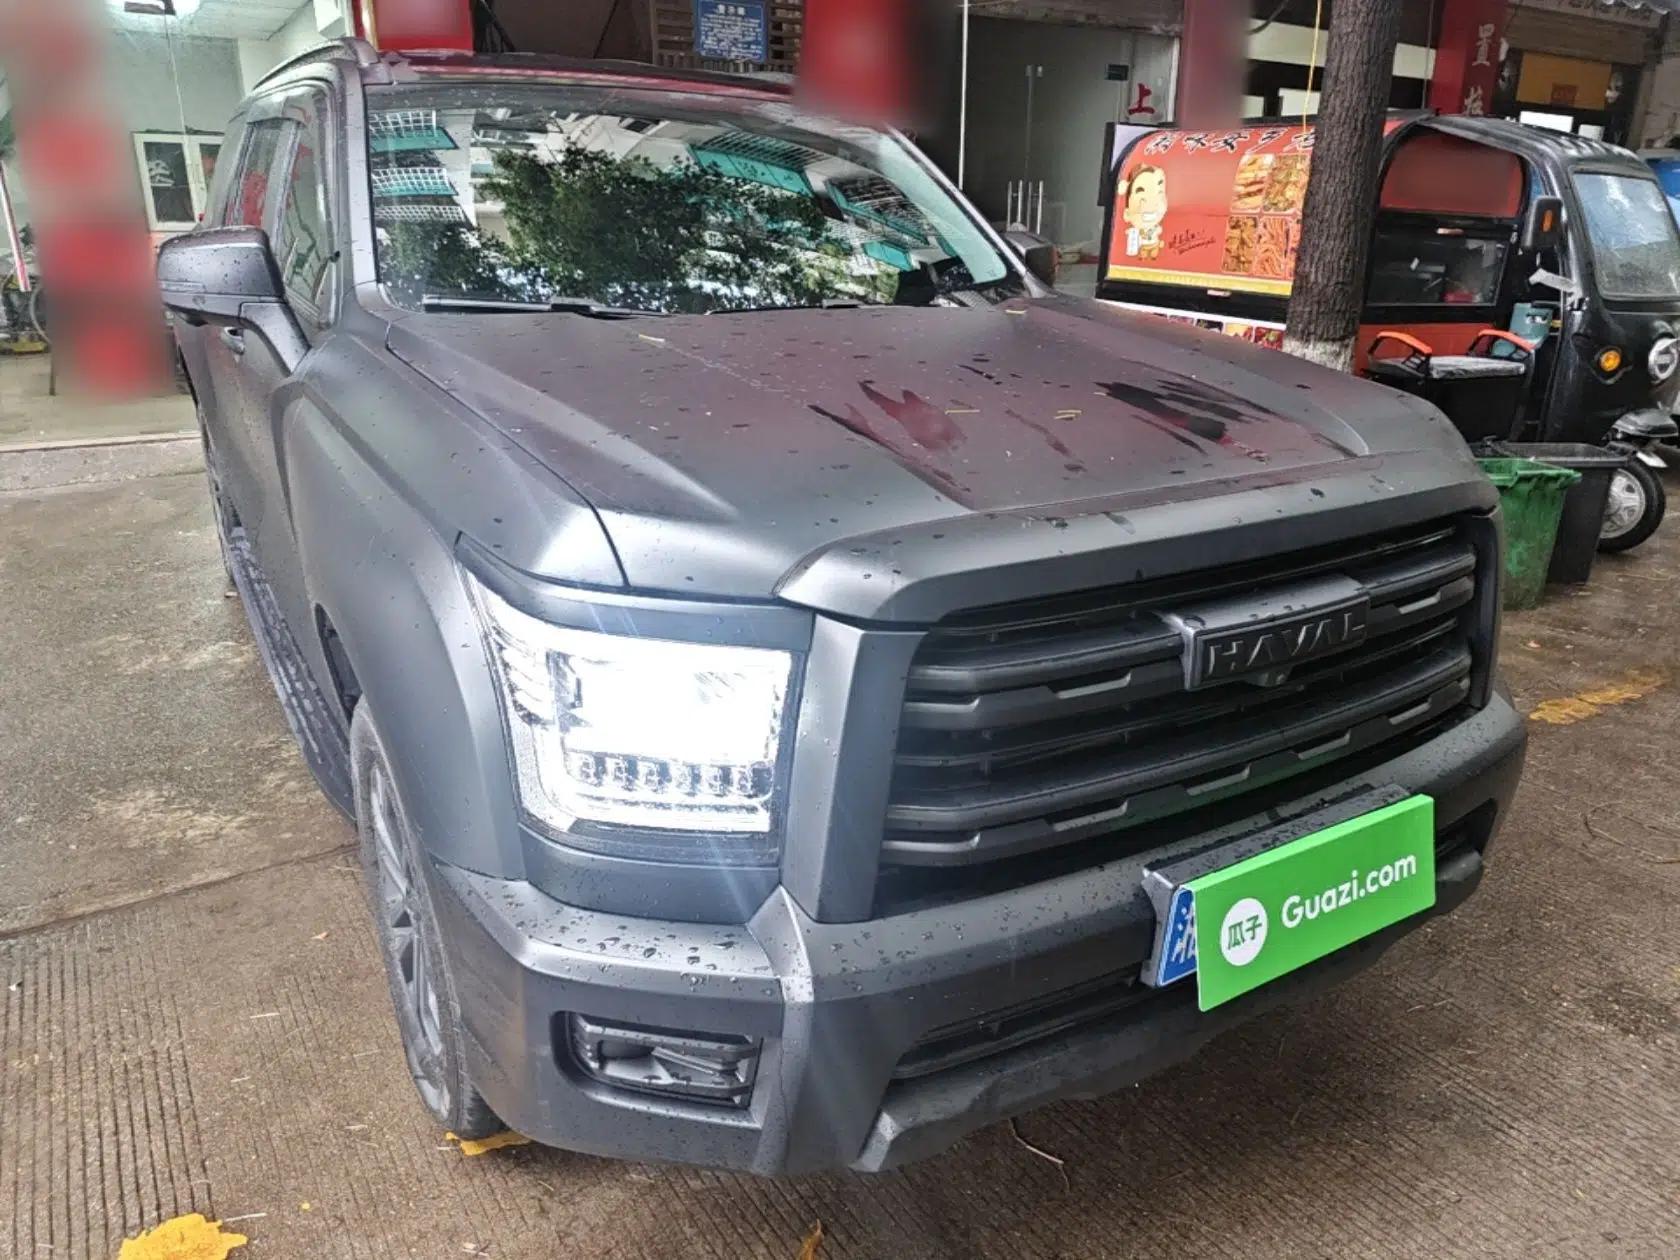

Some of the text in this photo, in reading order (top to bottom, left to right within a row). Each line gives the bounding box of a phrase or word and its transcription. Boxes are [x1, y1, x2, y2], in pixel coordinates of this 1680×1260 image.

[1128, 82, 1155, 115] 上
[1208, 612, 1366, 676] HAVAL
[1280, 854, 1417, 929] Guazi.com
[1226, 913, 1263, 951] 瓜子
